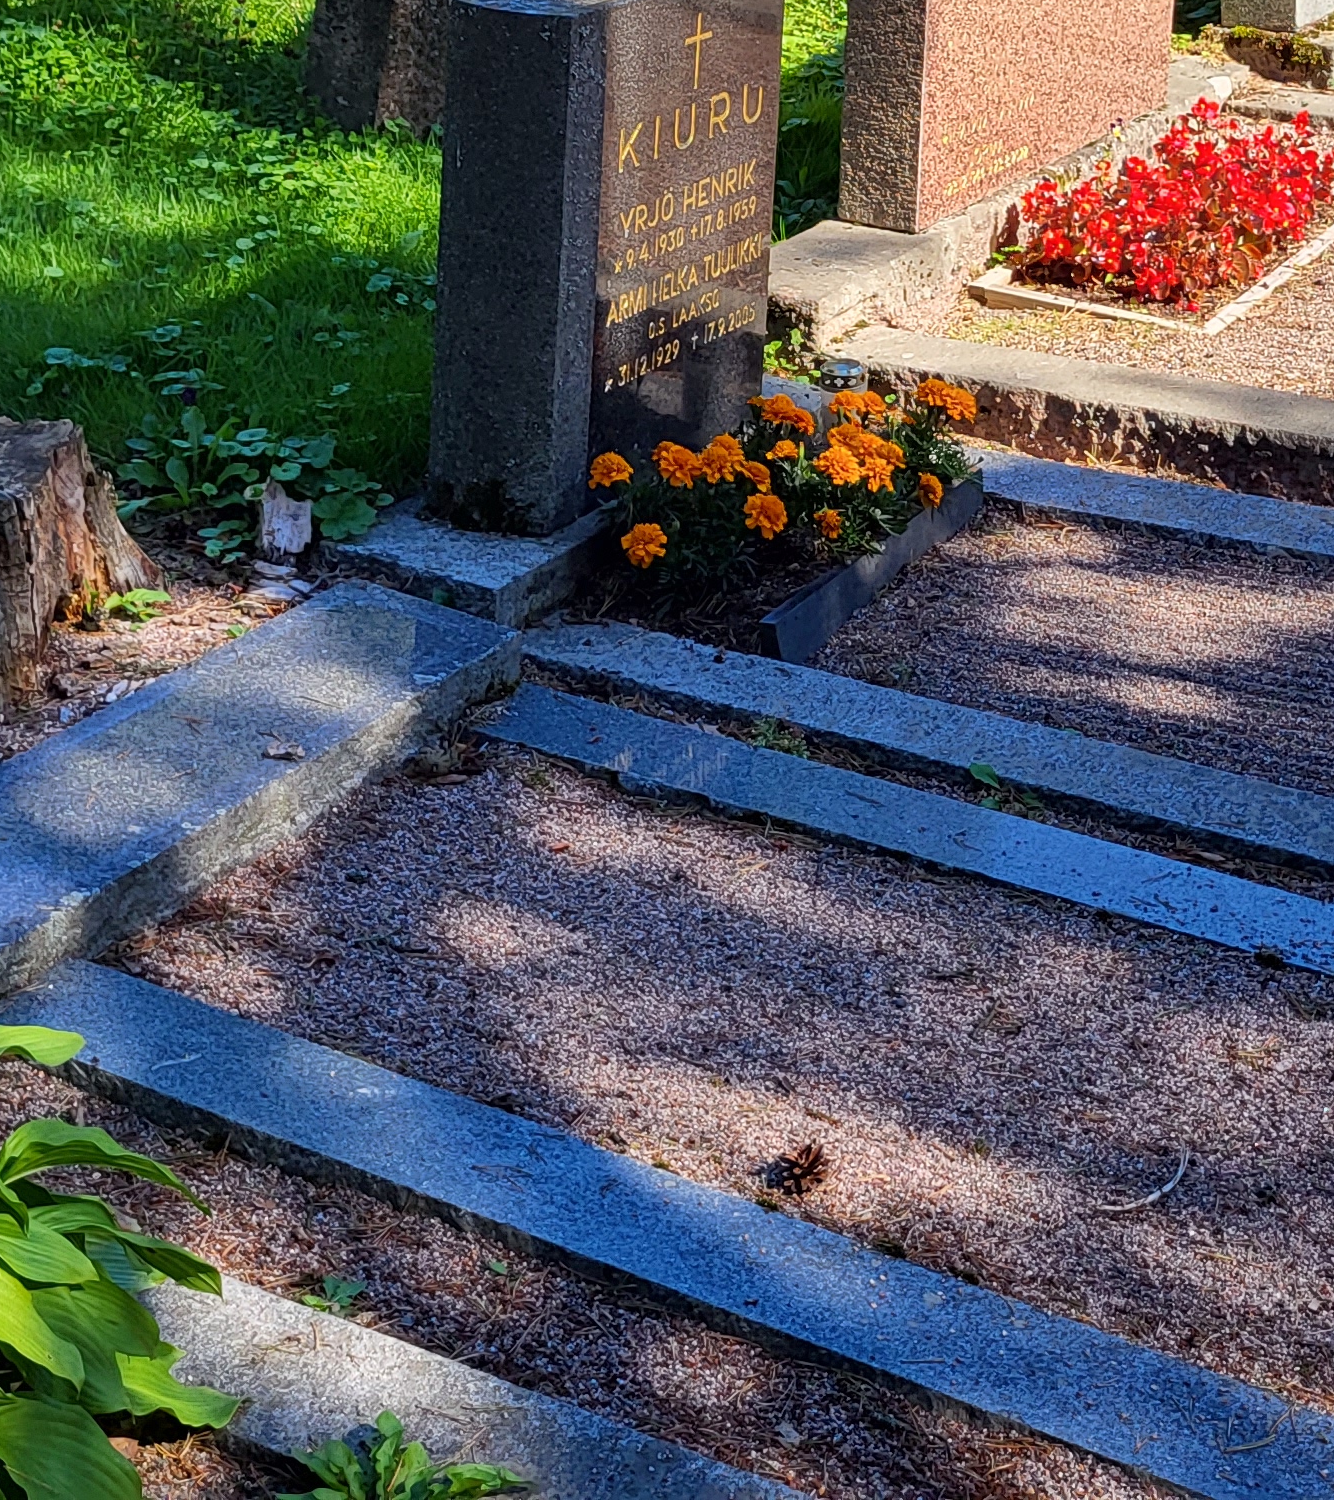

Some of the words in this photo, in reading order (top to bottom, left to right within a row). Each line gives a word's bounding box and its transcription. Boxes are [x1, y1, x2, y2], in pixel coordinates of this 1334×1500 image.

[618, 83, 764, 174] KIURU
[619, 187, 674, 235] YRJÖ
[682, 158, 757, 214] HENRIK
[605, 282, 648, 327] ARMI
[651, 263, 699, 306] HELKA
[703, 231, 763, 282] TUULIKKI
[671, 288, 721, 329] LAAKSO
